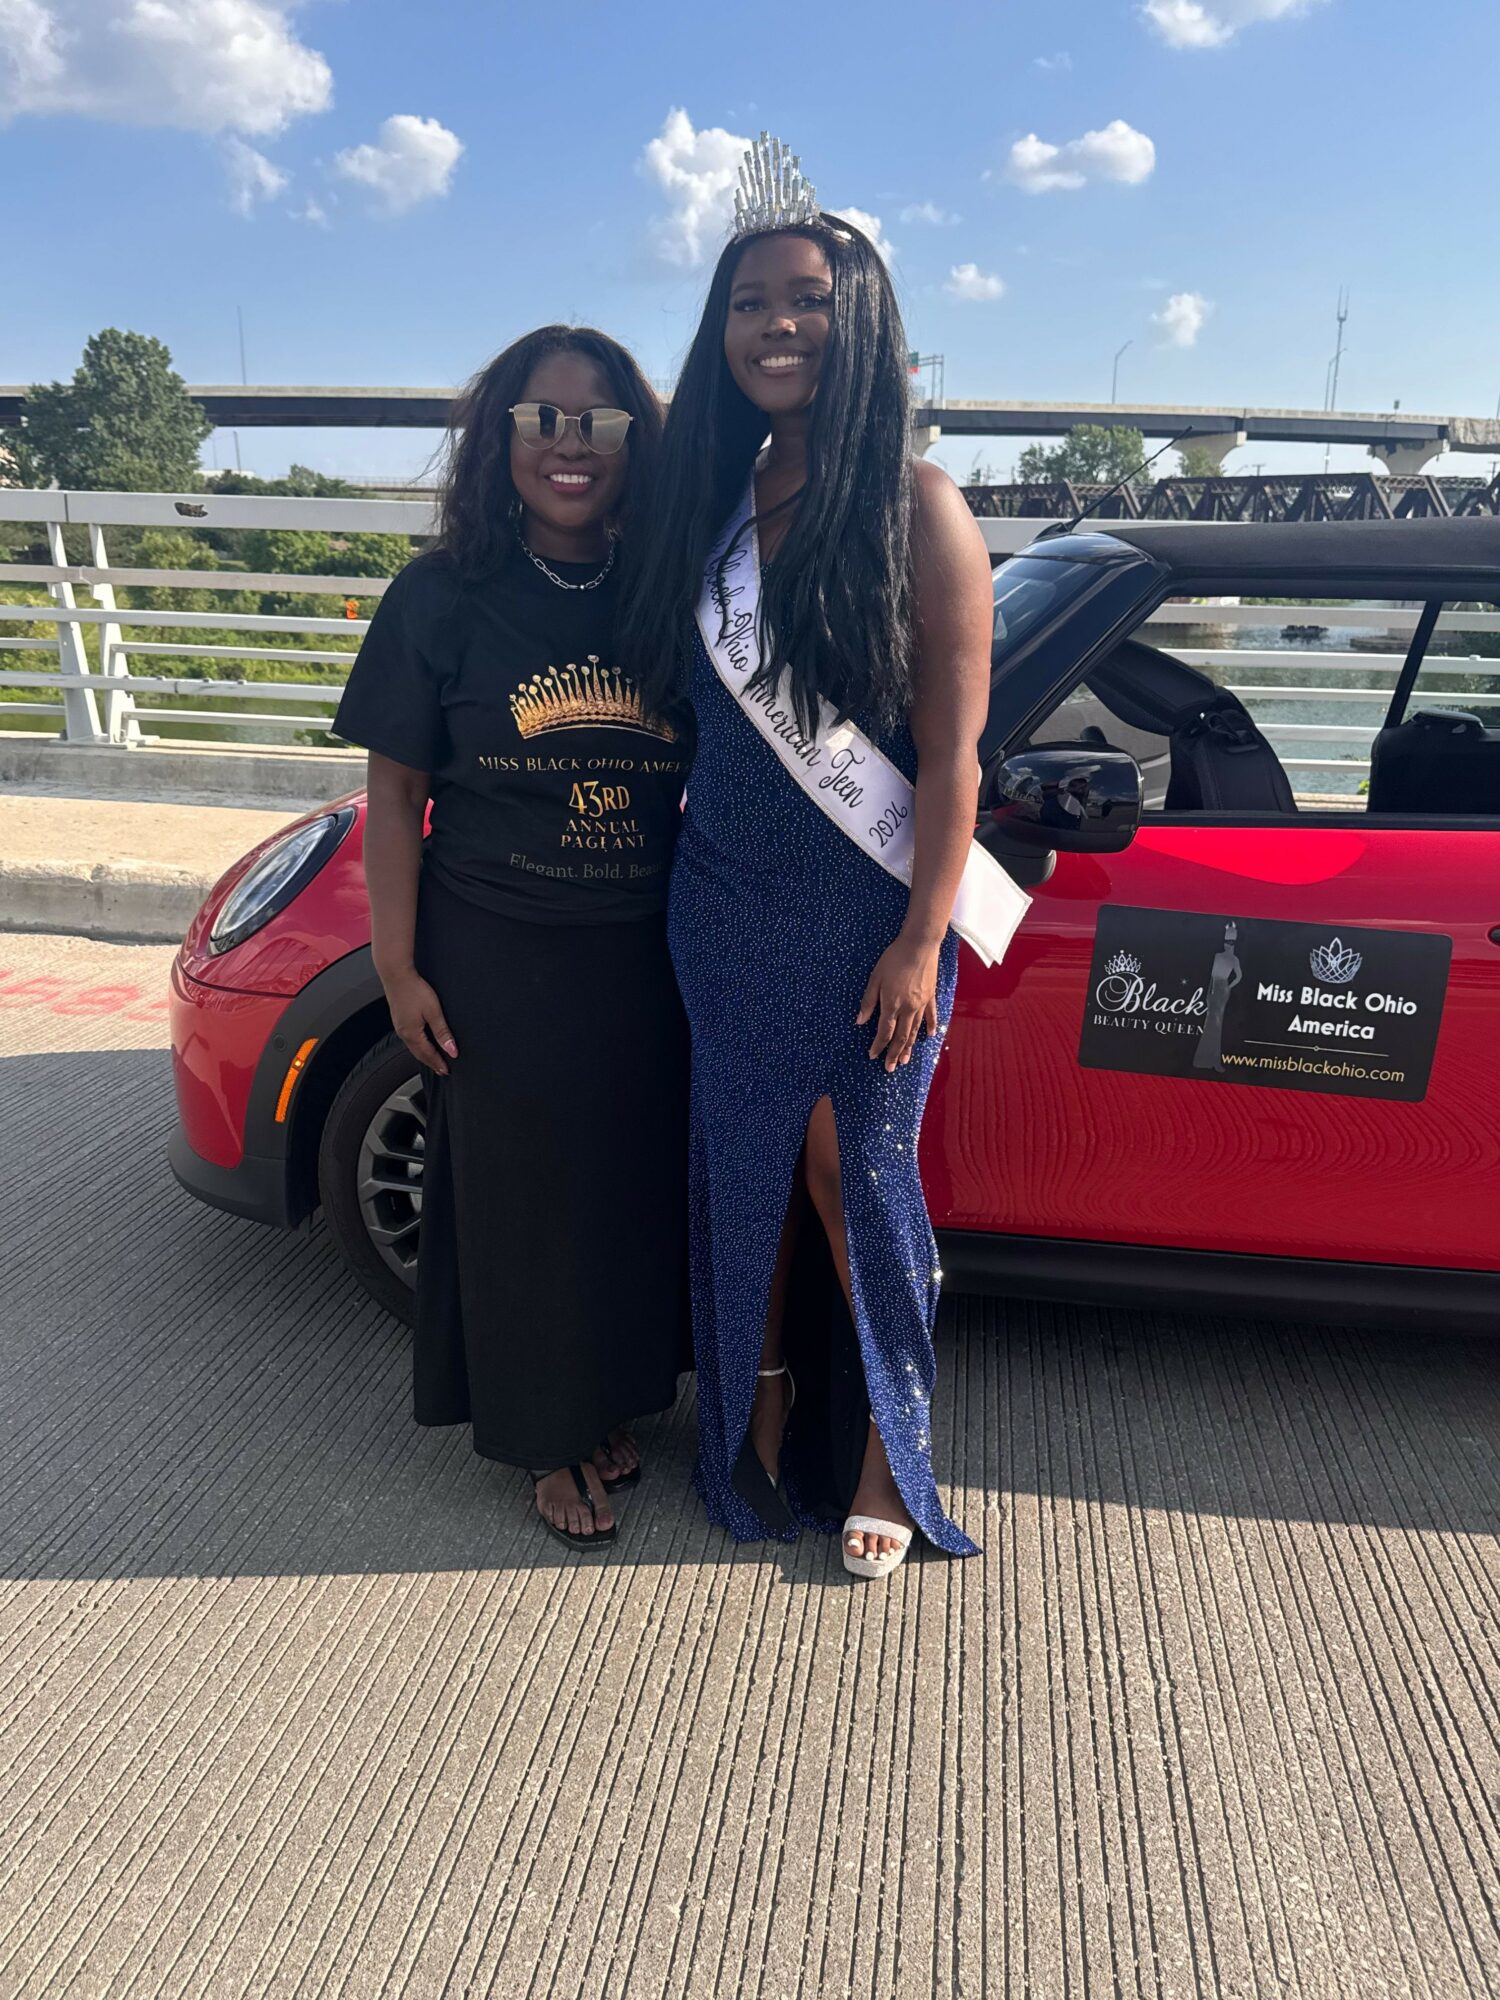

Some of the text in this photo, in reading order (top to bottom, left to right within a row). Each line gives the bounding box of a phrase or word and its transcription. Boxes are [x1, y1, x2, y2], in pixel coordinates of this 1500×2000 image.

[719, 608, 755, 671] Ohio
[819, 748, 865, 808] Teen
[479, 756, 519, 771] MISS
[527, 757, 581, 772] BLACK
[588, 757, 634, 771] OHIO
[569, 780, 630, 818] 43RD
[566, 819, 640, 834] ANNUAL
[869, 801, 908, 848] 2026
[560, 834, 645, 852] PAGEANT
[510, 853, 578, 879] Elegant.
[583, 863, 624, 879] Bold.
[1096, 971, 1208, 1017] Black
[1256, 982, 1417, 1016] Miss Black Ohio
[1093, 1014, 1150, 1030] BEAUTY
[1287, 1014, 1375, 1040] America
[1221, 1053, 1405, 1082] www.missblackohio.com
